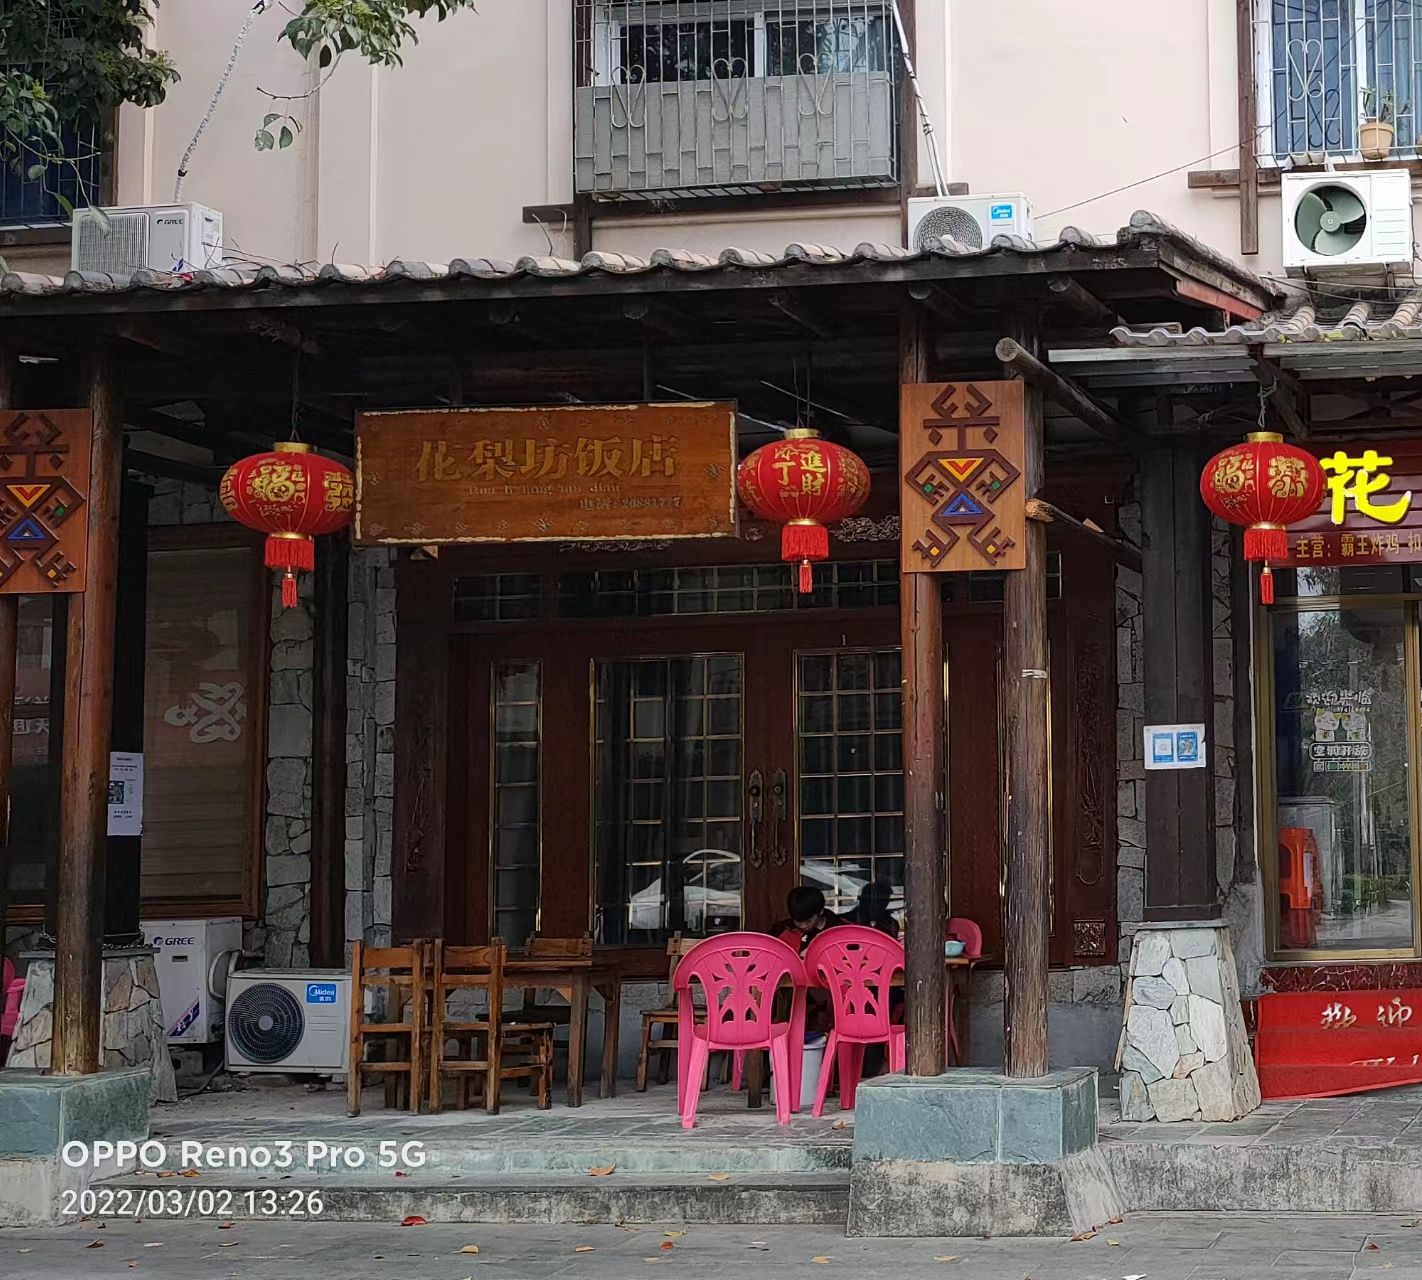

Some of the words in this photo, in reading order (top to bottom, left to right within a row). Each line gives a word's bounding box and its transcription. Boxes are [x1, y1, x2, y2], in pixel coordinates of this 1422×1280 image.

[414, 434, 680, 482] 花梨坊饭店
[1341, 532, 1400, 556] 霸王炸鸡
[165, 936, 195, 946] GREE
[311, 986, 335, 997] Midea
